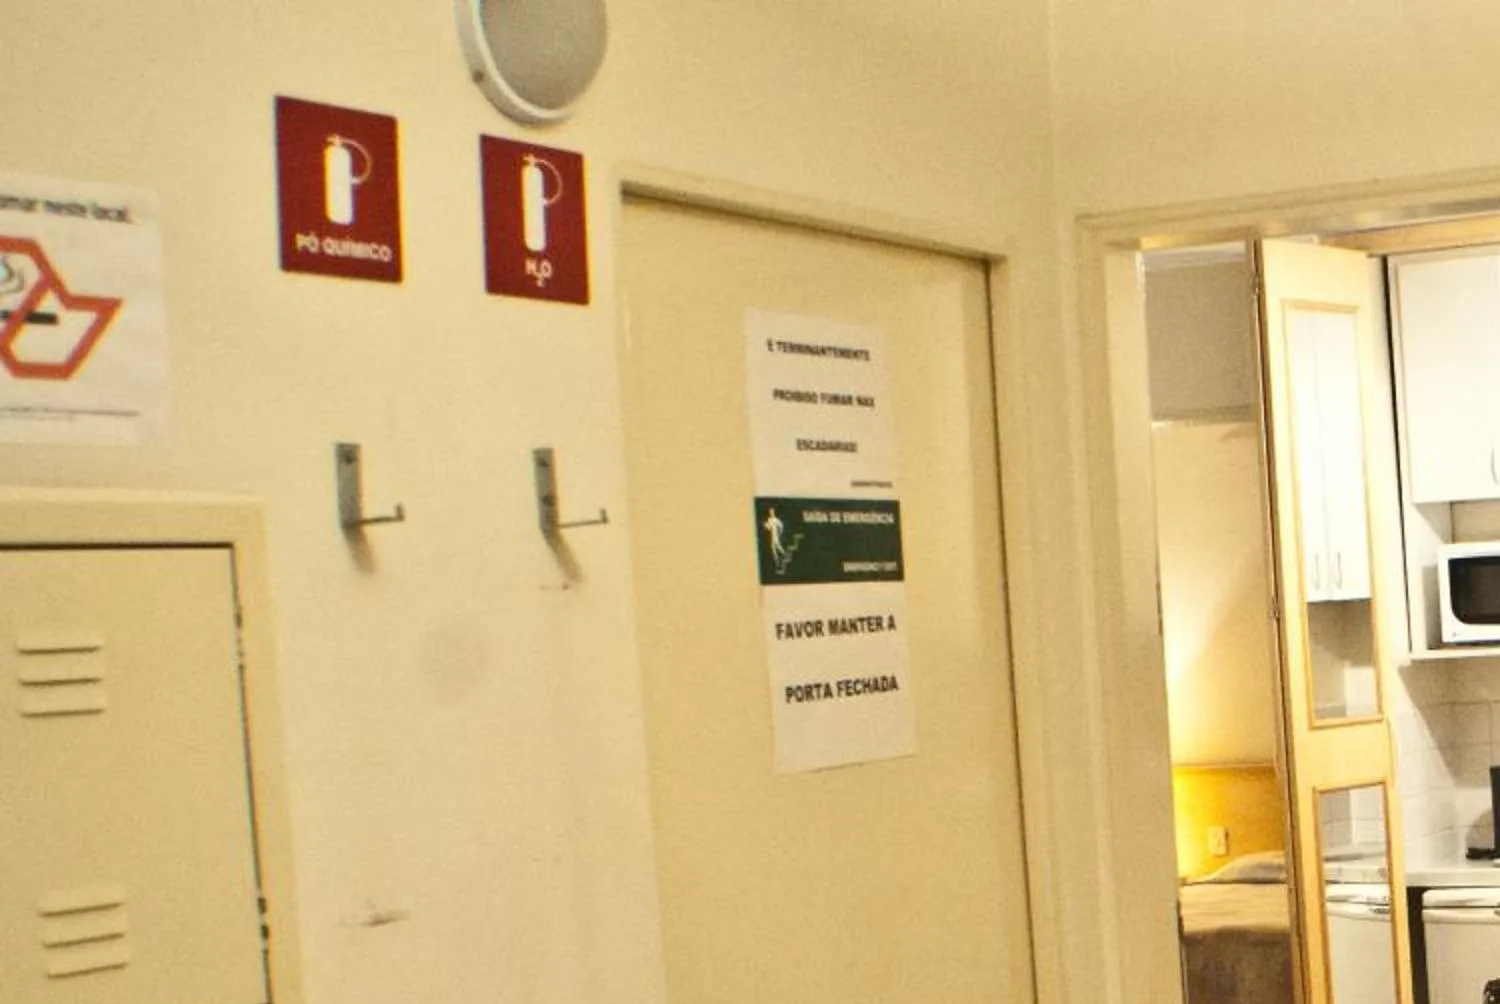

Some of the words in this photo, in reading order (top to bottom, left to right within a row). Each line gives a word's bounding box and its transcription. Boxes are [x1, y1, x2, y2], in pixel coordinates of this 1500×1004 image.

[775, 619, 825, 641] FAVOR
[827, 615, 884, 637] MANTER
[884, 612, 897, 632] A
[785, 682, 834, 704] PORTA
[836, 674, 900, 698] FECHADA
